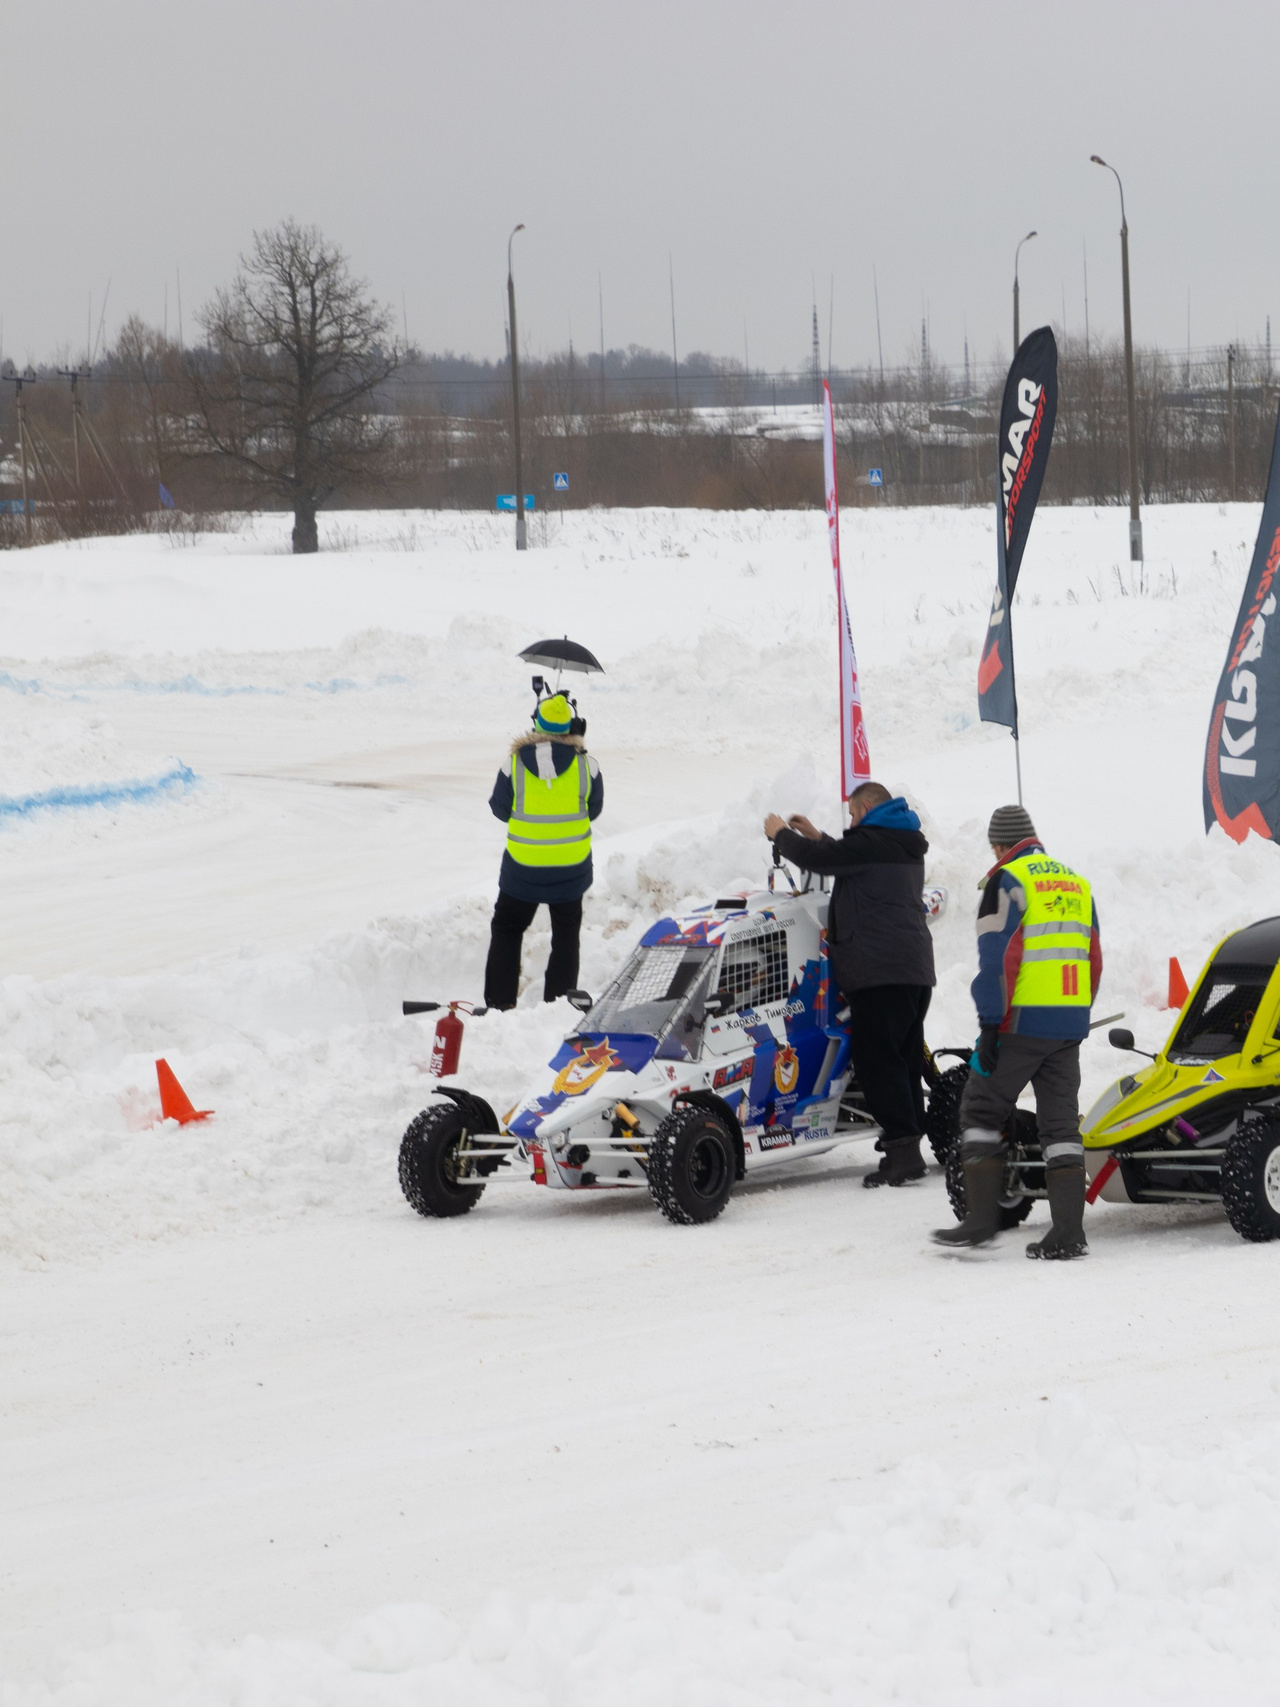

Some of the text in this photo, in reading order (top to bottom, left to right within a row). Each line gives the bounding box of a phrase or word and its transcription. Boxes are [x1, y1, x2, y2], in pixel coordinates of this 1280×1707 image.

[725, 1000, 805, 1030] Жарков Тимофей
[761, 1133, 793, 1148] KRAMAR
